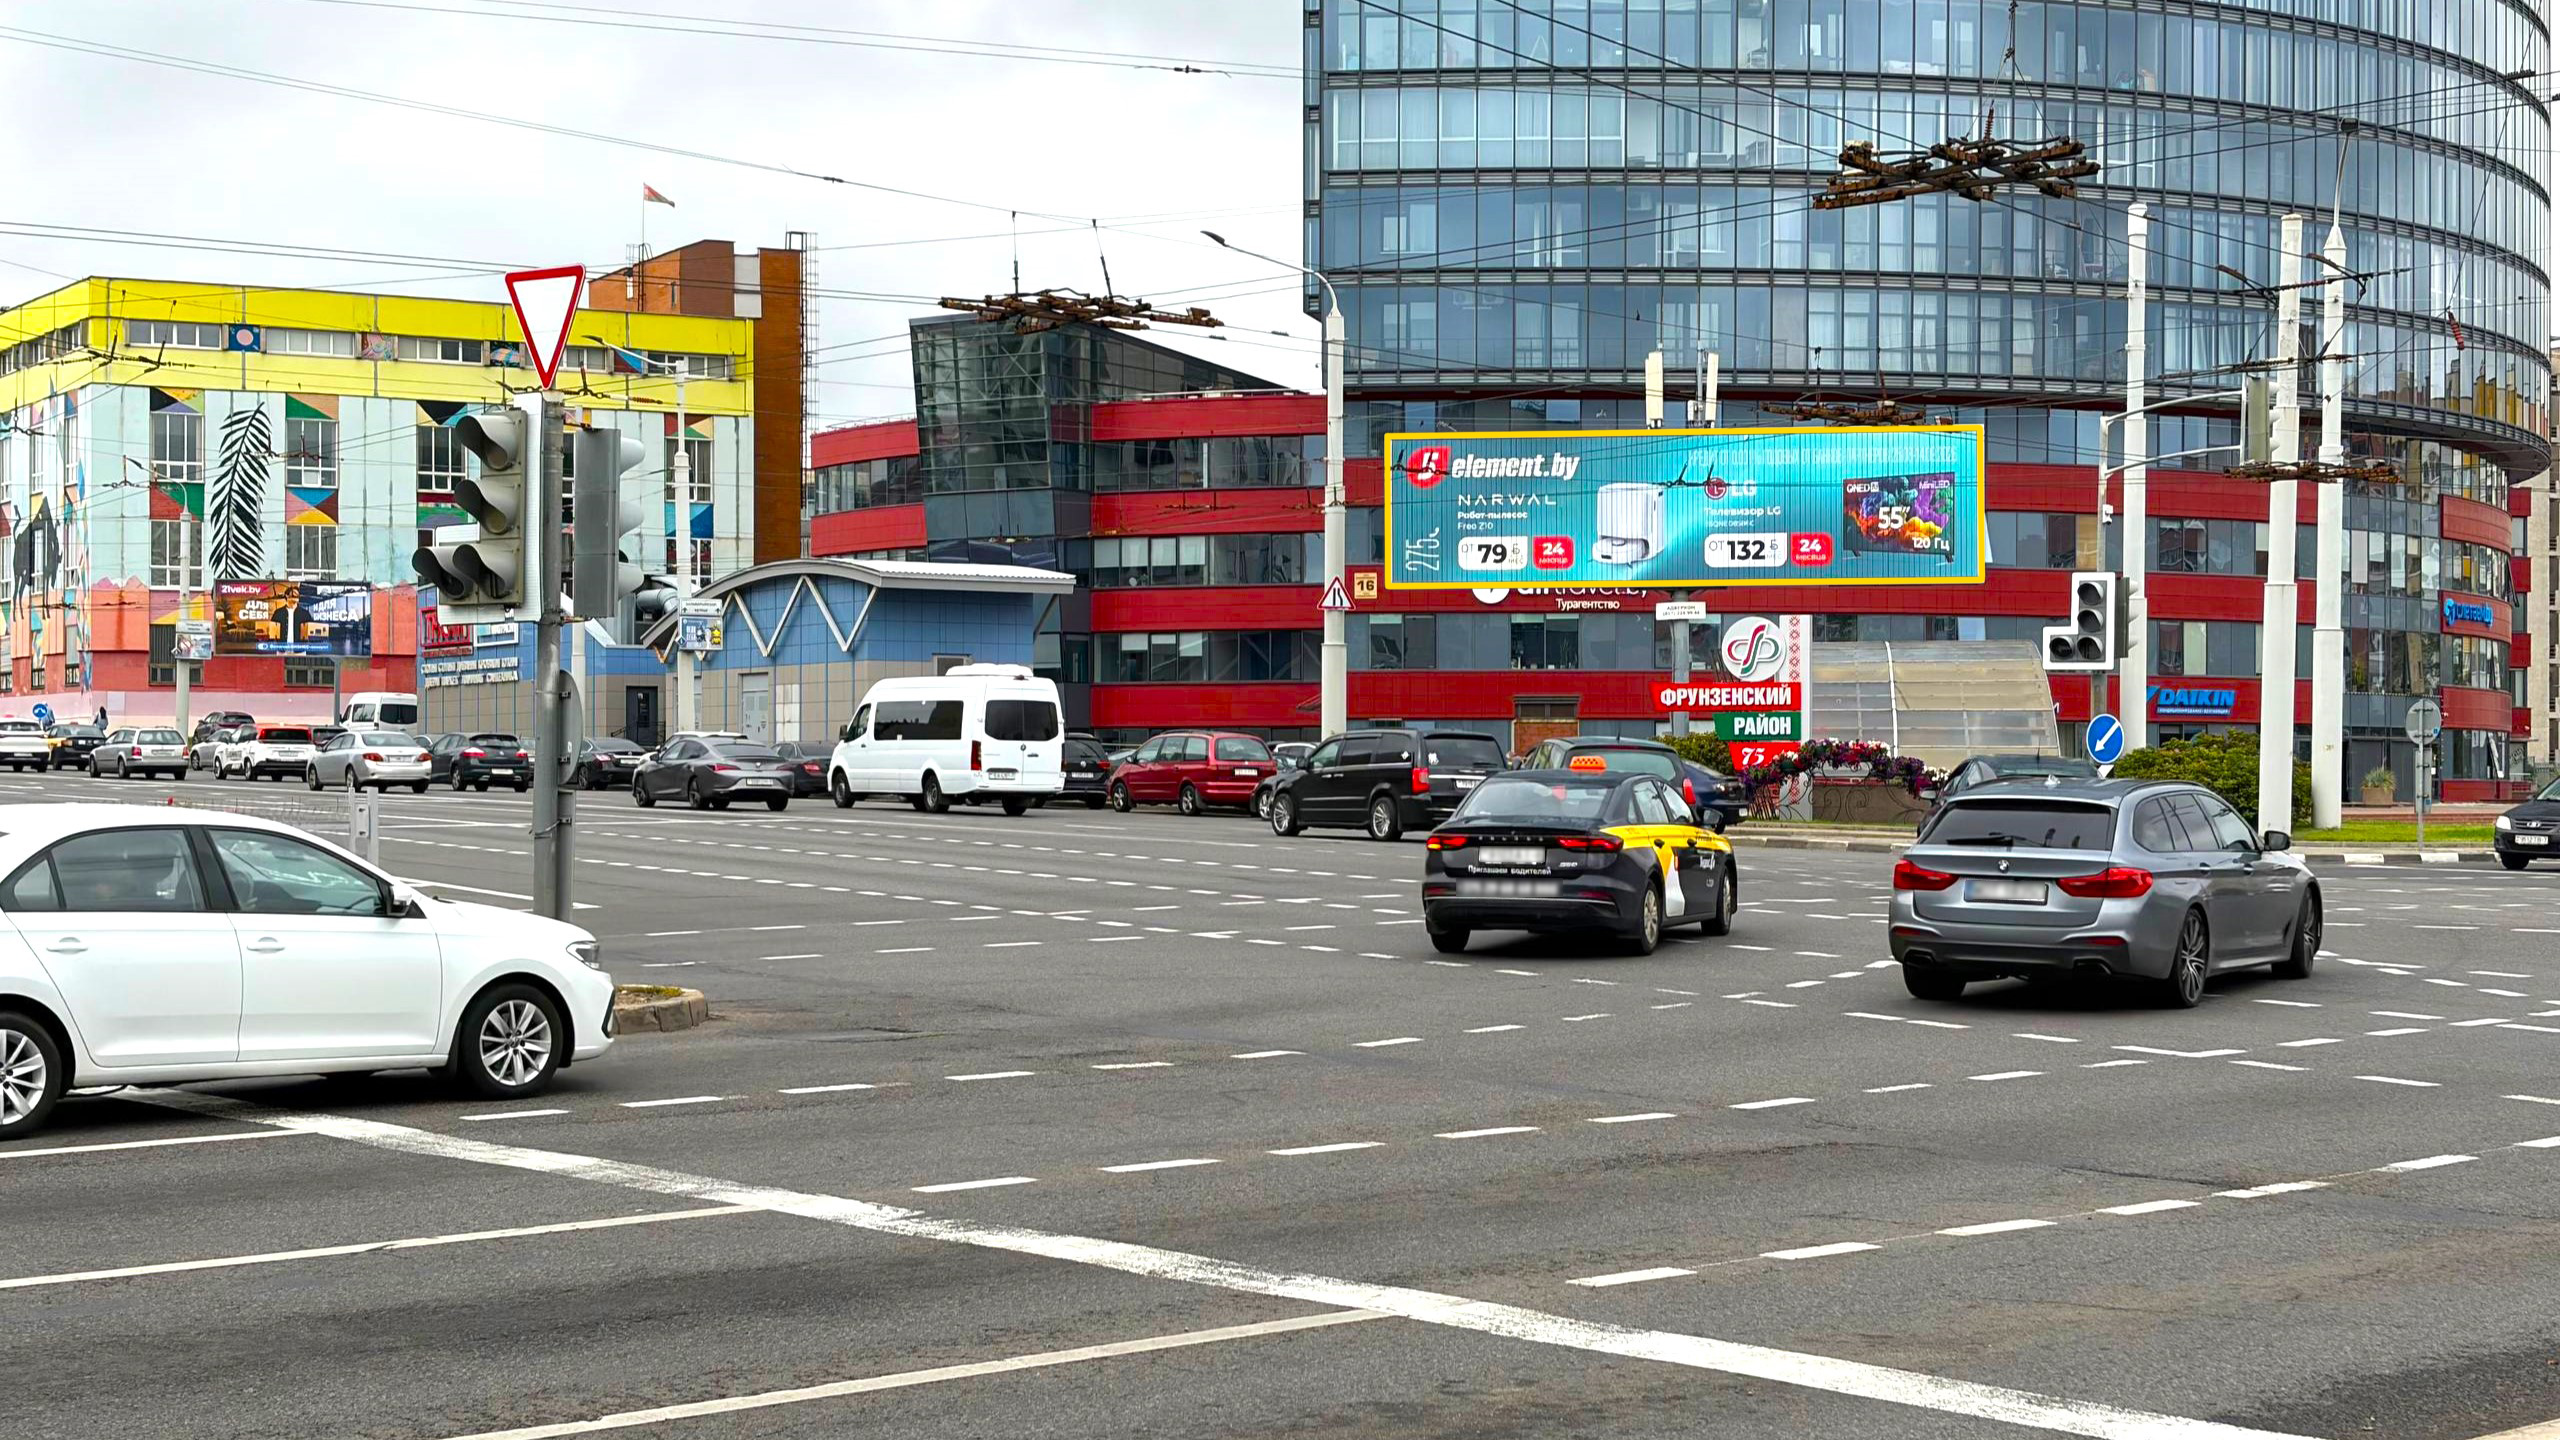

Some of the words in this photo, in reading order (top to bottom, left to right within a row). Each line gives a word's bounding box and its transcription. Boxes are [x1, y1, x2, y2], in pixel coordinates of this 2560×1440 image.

[1451, 452, 1580, 480] element.by
[1731, 479, 1757, 497] LG
[1919, 479, 1950, 490] MiniLED
[1458, 493, 1557, 506] NARWAL
[1767, 506, 1781, 516] LG
[1542, 542, 1565, 555] 24
[1799, 539, 1821, 553] 24
[1912, 536, 1930, 549] 120
[1405, 538, 1440, 571] 275
[1477, 543, 1508, 564] 79
[1726, 540, 1766, 561] 132
[221, 585, 261, 596] 21vek.by
[1357, 580, 1375, 591] 16
[245, 600, 269, 611] ДЛЯ
[1555, 598, 1620, 610] Турагентство
[239, 609, 269, 620] СЕБЯ
[1660, 684, 1792, 707] ФРУНЗЕНСКИЙ
[2157, 689, 2236, 707] DAIKIN
[1734, 714, 1792, 736] РАЙОН
[1741, 747, 1765, 766] 75
[1468, 864, 1508, 874] Приглашаем
[1511, 866, 1552, 875] водителей
